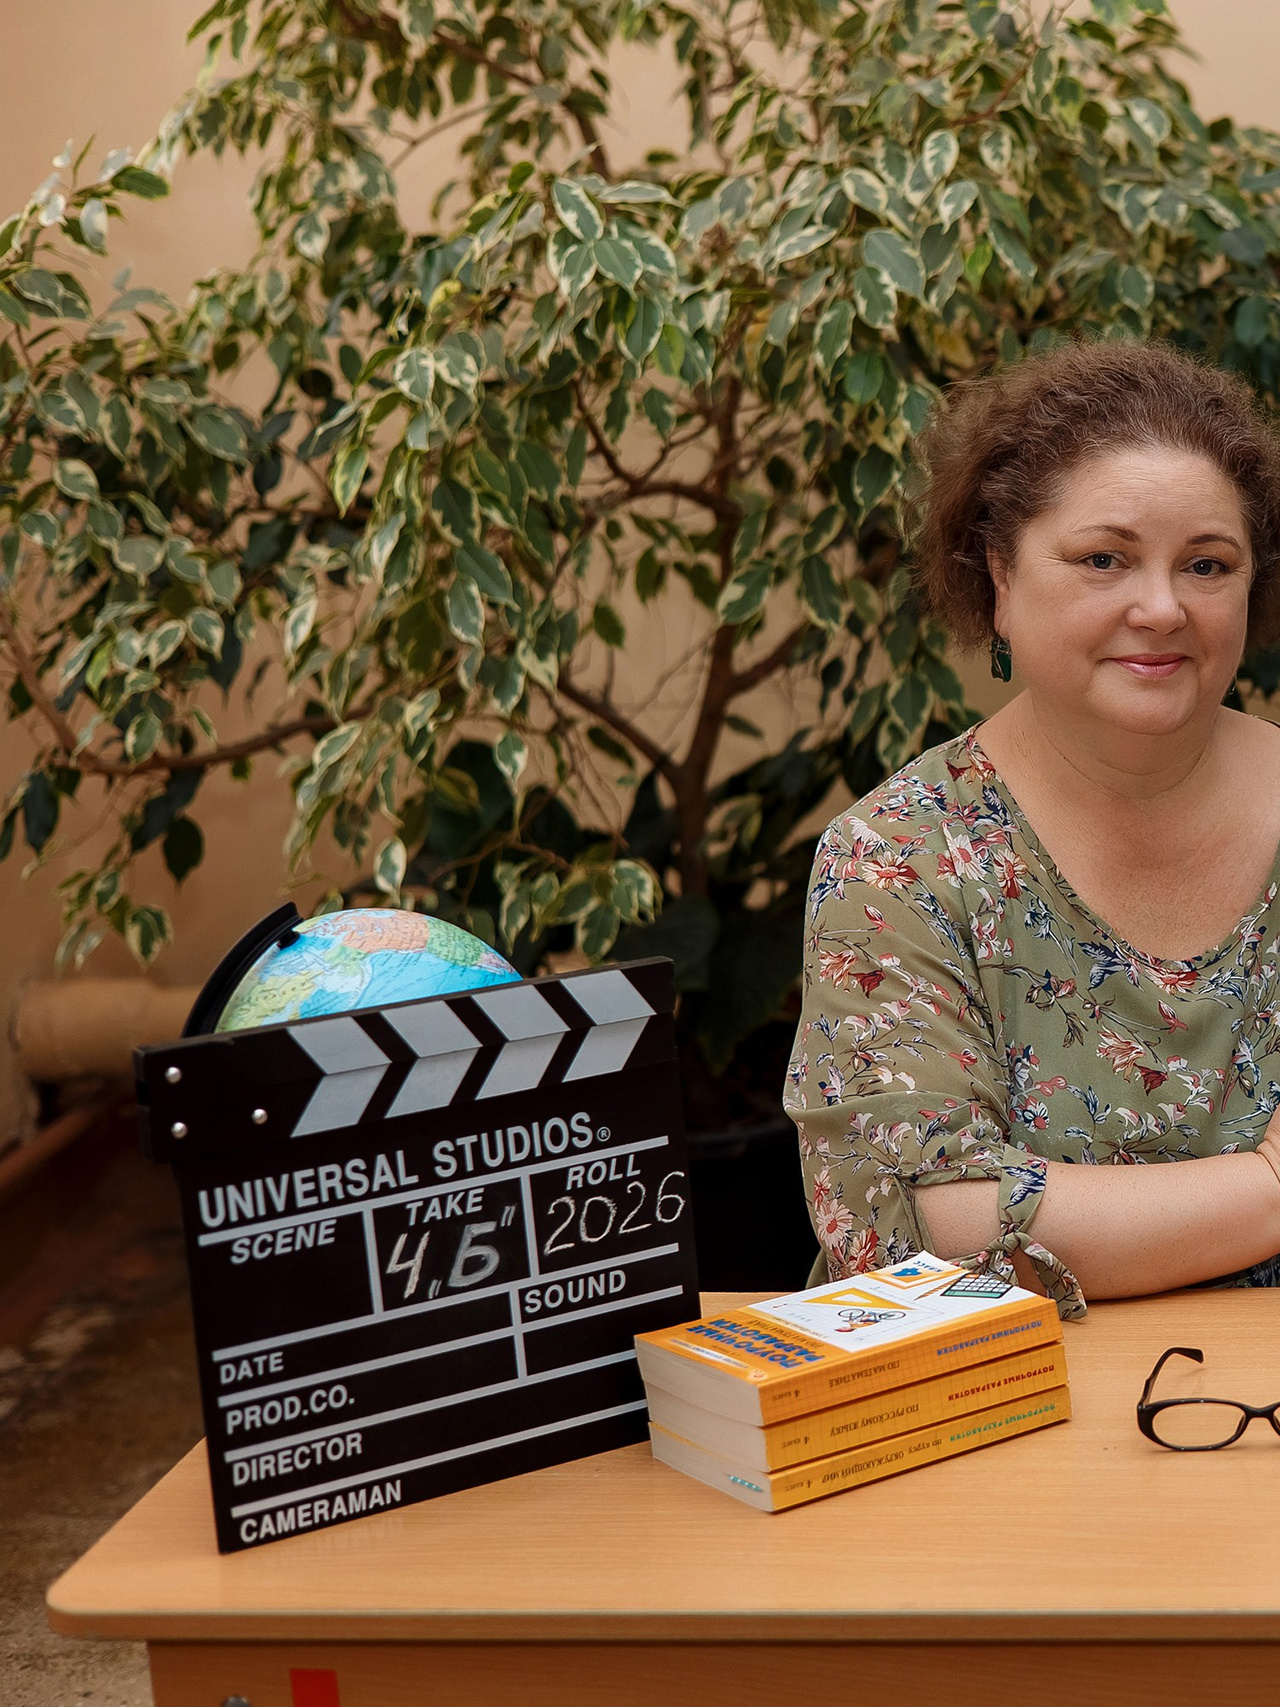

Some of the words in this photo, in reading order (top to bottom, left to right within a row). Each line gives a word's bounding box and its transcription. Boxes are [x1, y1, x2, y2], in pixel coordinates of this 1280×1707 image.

[565, 1154, 642, 1191] ROLL
[198, 1149, 419, 1229] UNIVERSAL
[405, 1187, 485, 1227] TAKE
[543, 1170, 686, 1257] 2026
[230, 1219, 338, 1265] SCENE
[523, 1269, 627, 1314] SOUND
[708, 1318, 826, 1363] РАЗРАБОТКИ
[991, 1319, 1043, 1340] ПОУРОЧНЫЕ
[686, 1324, 804, 1369] ПОУРОЧНЫЕ
[936, 1335, 991, 1357] РАЗРАБОТКИ
[219, 1351, 285, 1386] DATE
[828, 1363, 886, 1388] МАТЕМАТИКЕ
[886, 1359, 900, 1370] ПО
[1003, 1364, 1055, 1385] ПОУРОЧНЫЕ
[947, 1379, 1002, 1402] РАЗРАБОТКИ
[225, 1384, 356, 1436] PROD.CO.
[859, 1407, 905, 1427] РУССКОМУ
[905, 1403, 920, 1415] ПО
[1004, 1403, 1056, 1425] ПОУРОЧНЫЕ
[829, 1421, 859, 1437] ЯЗЫКУ
[949, 1420, 1003, 1442] РАЗРАБОТКИ
[232, 1432, 363, 1487] DIRECTOR
[907, 1441, 932, 1455] курсу
[821, 1470, 841, 1484] МИР
[840, 1450, 905, 1479] ОКРУЖАЮЩИЙ
[239, 1479, 402, 1544] CAMERAMAN
